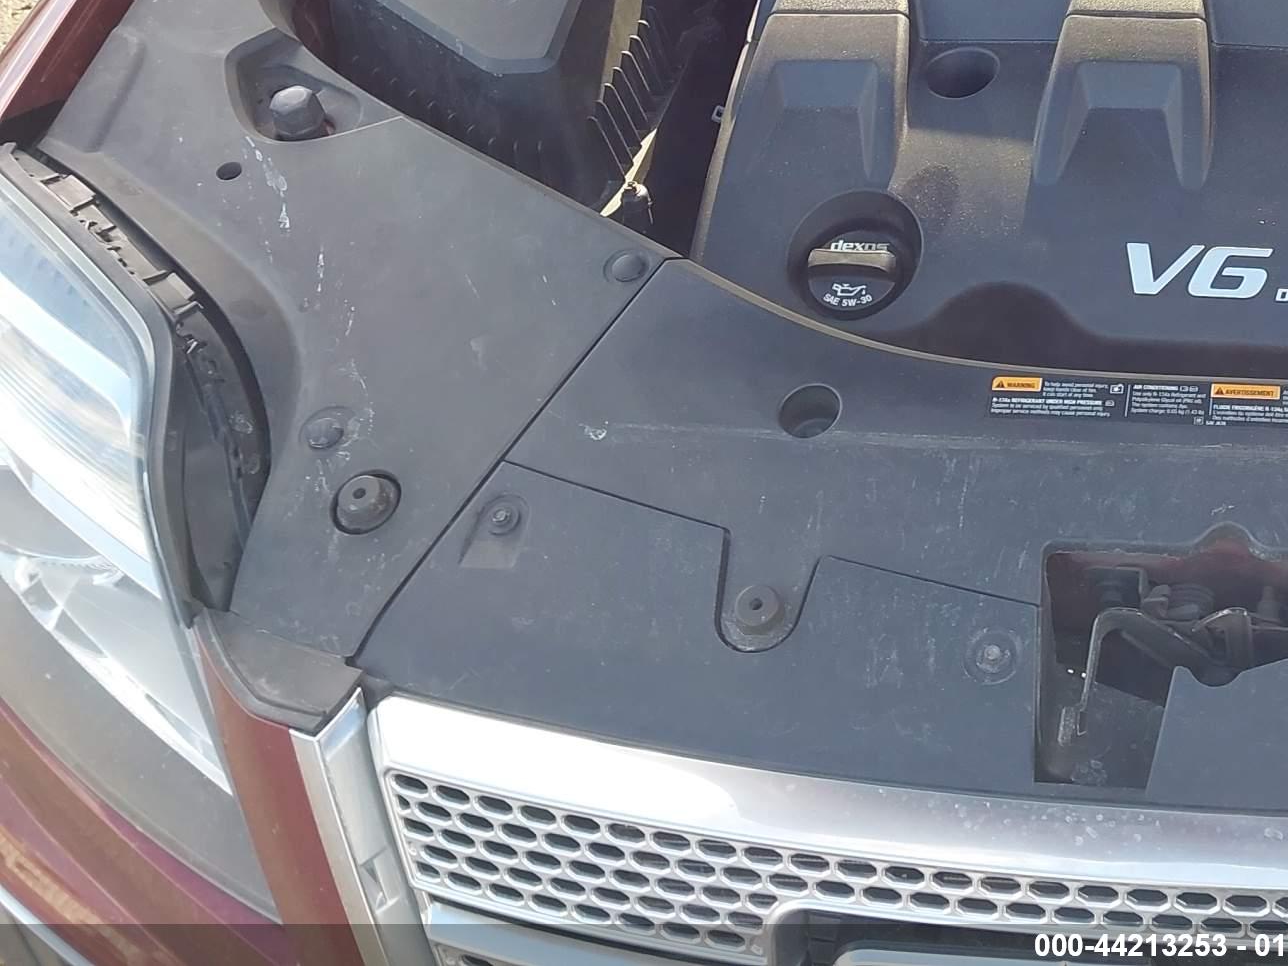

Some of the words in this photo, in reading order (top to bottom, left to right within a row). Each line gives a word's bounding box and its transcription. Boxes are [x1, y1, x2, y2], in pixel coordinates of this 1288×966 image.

[830, 239, 891, 252] dexos
[1126, 242, 1274, 299] V6
[823, 293, 841, 307] SAE
[841, 294, 873, 307] 5W-30
[1007, 381, 1036, 389] WARNING
[1226, 389, 1274, 397] AVERTISSEMENT
